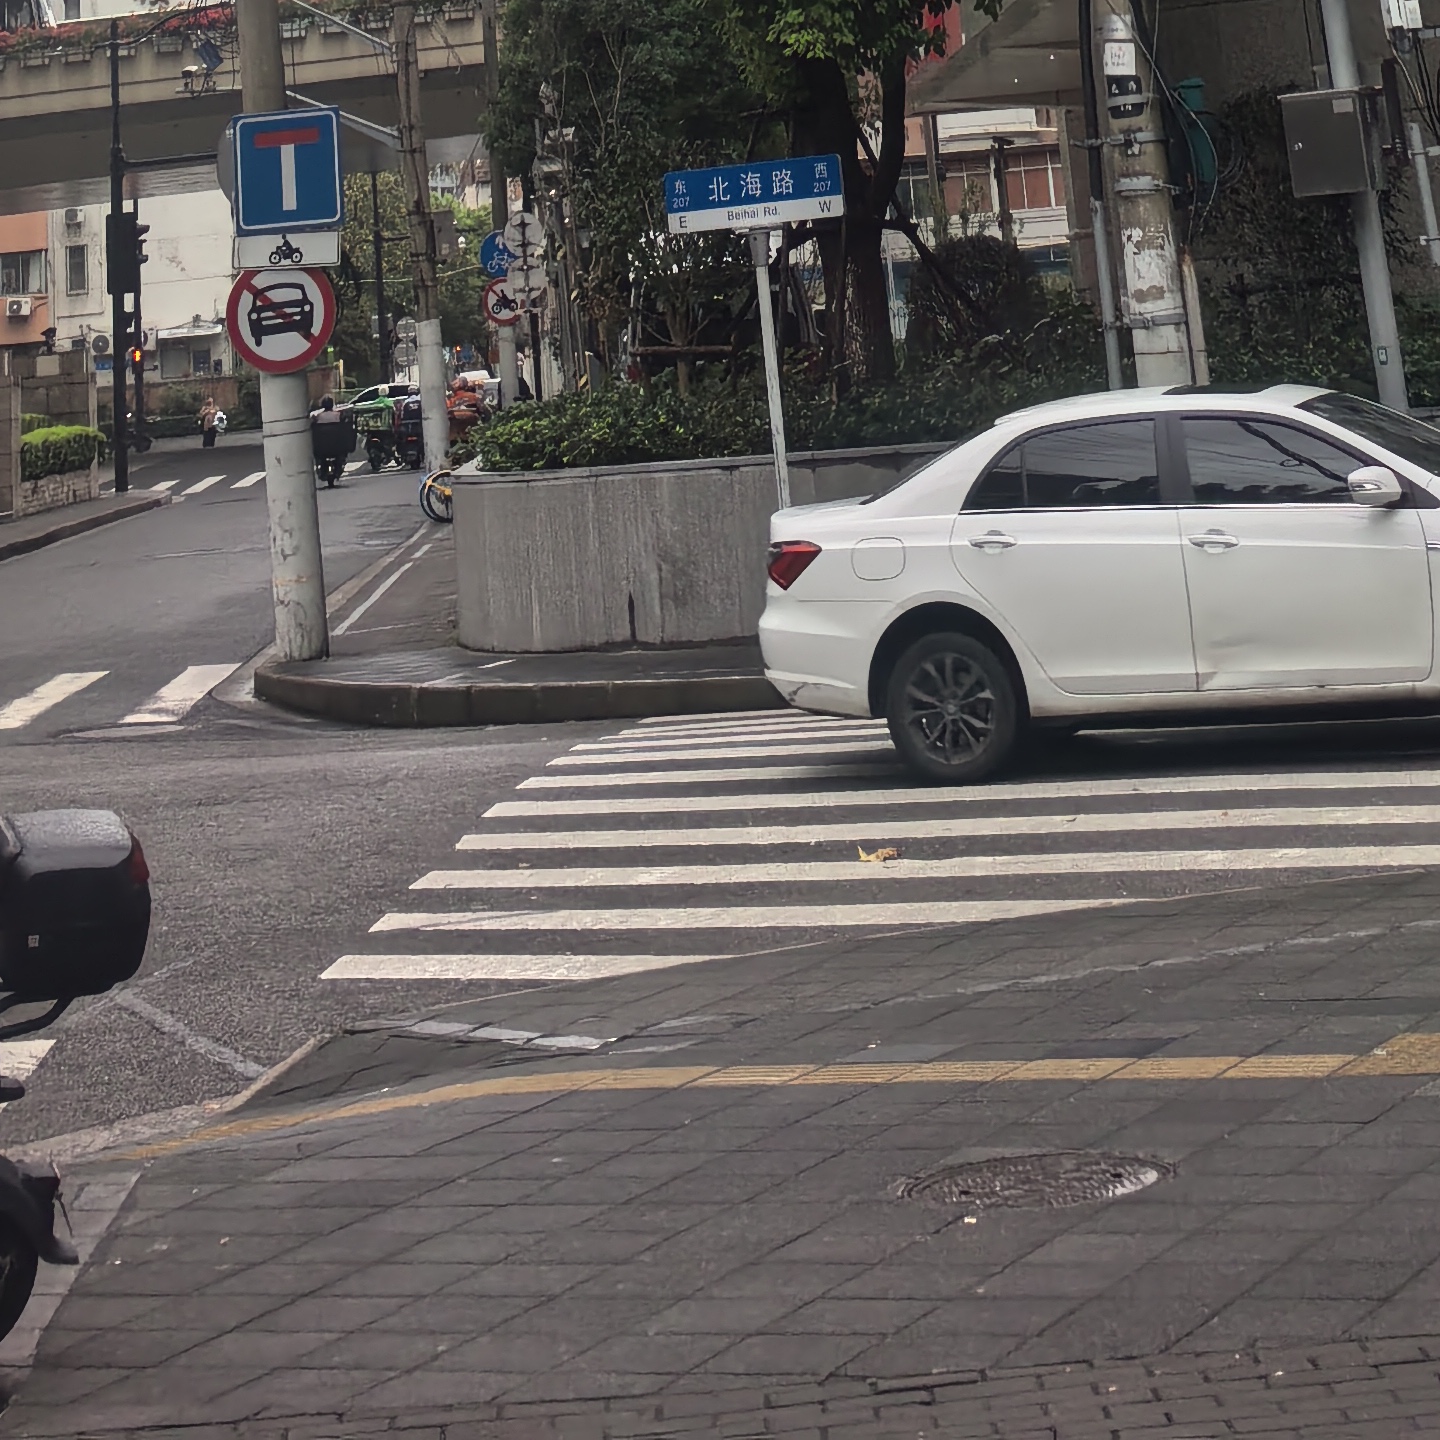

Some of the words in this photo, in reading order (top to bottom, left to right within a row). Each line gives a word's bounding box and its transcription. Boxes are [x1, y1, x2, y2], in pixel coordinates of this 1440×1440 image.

[672, 196, 690, 209] 207
[813, 180, 831, 193] 207
[674, 179, 686, 195] 东
[708, 168, 794, 202] 北海路
[814, 162, 828, 179] 西
[679, 216, 688, 229] E
[727, 209, 759, 221] Beihai
[763, 206, 781, 218] Rd.
[819, 200, 832, 213] W
